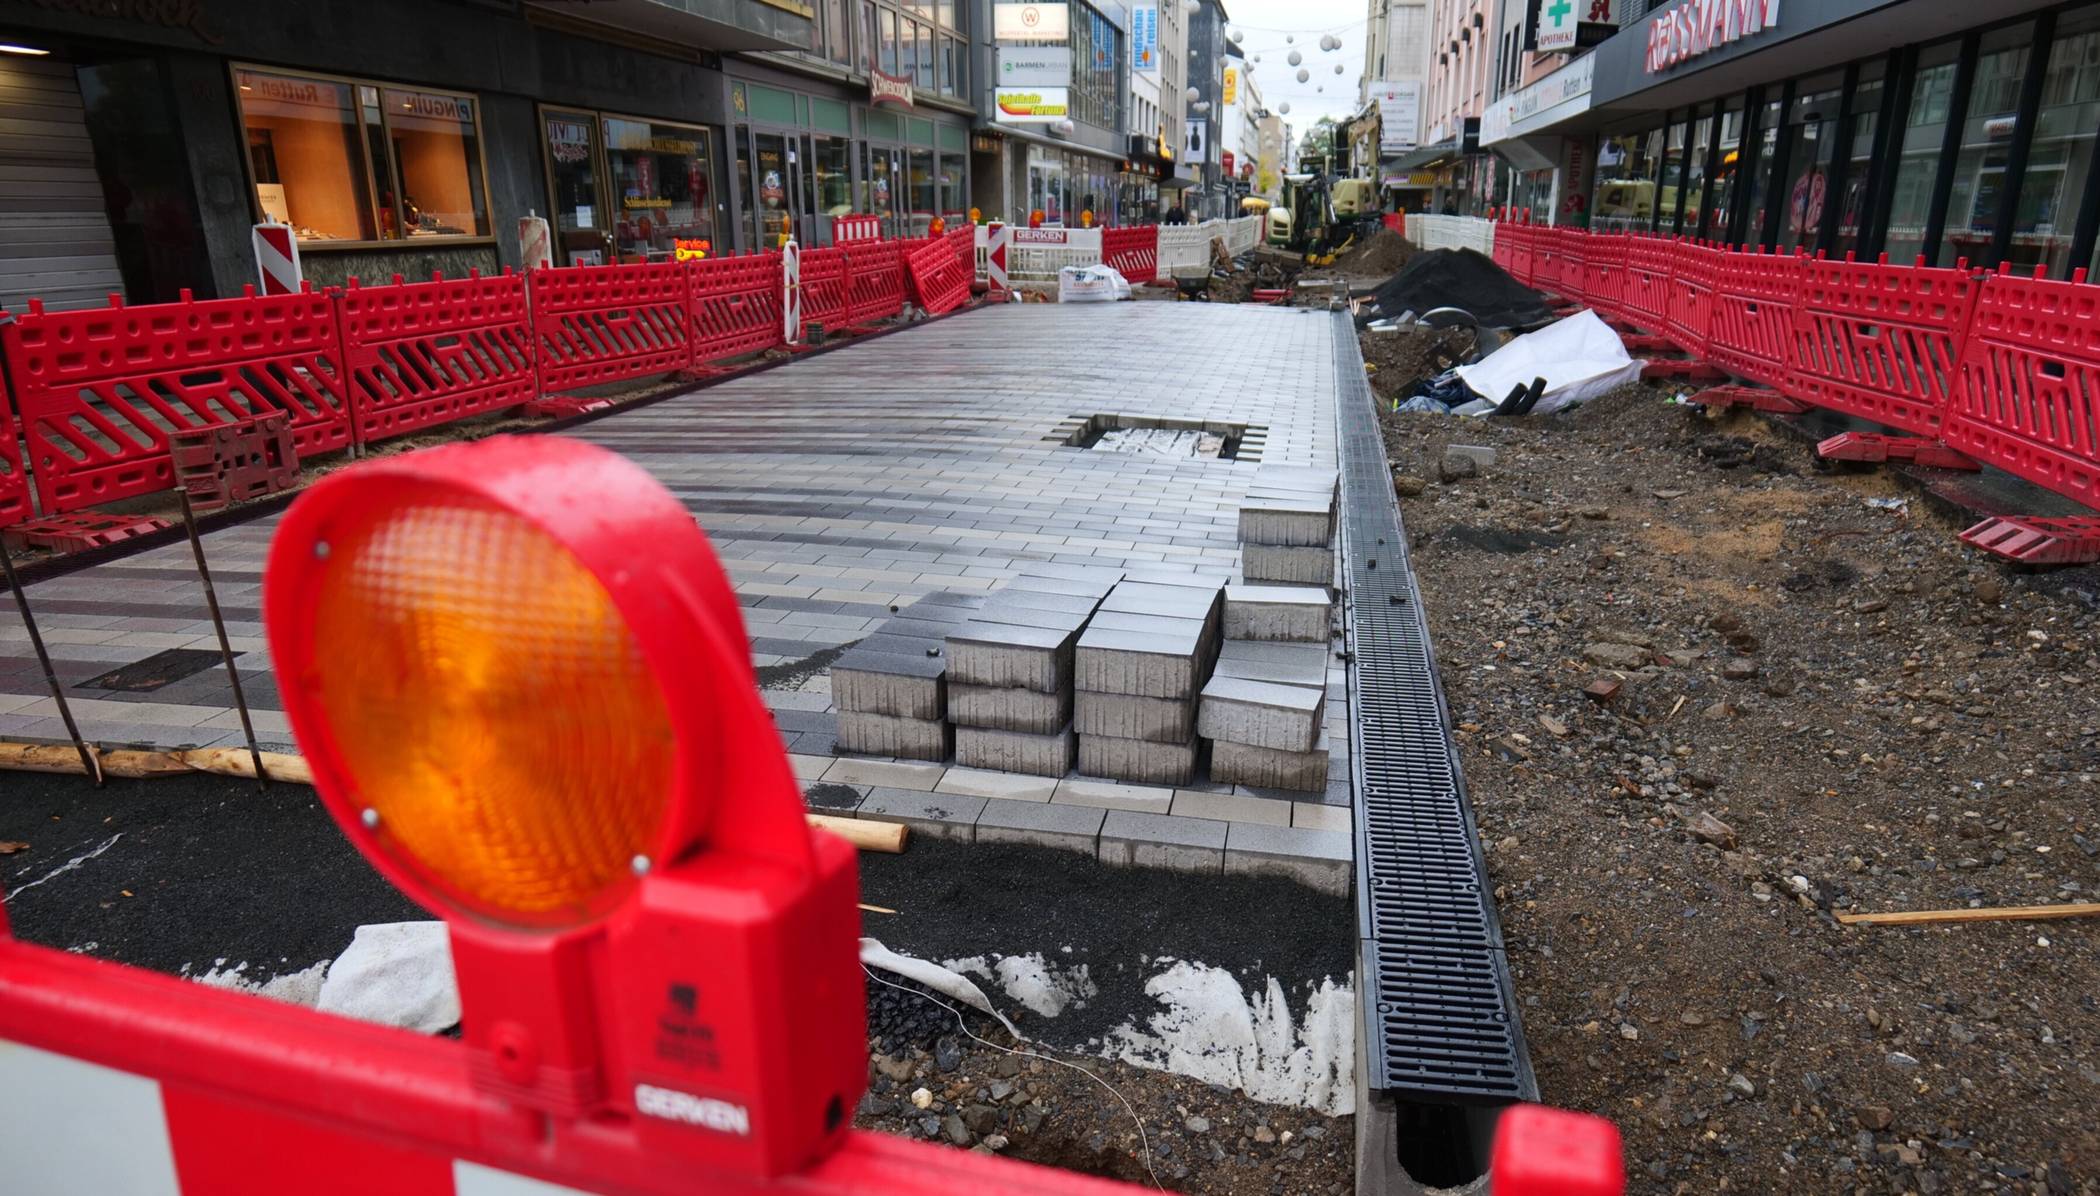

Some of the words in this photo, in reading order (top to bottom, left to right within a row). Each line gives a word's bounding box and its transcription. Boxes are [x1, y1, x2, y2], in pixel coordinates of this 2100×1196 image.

[1133, 9, 1143, 67] rundschau
[1146, 9, 1156, 44] reisen
[1540, 32, 1574, 46] APOTHEKE
[1016, 230, 1064, 240] GERKEN
[635, 1083, 749, 1136] GERKEN
